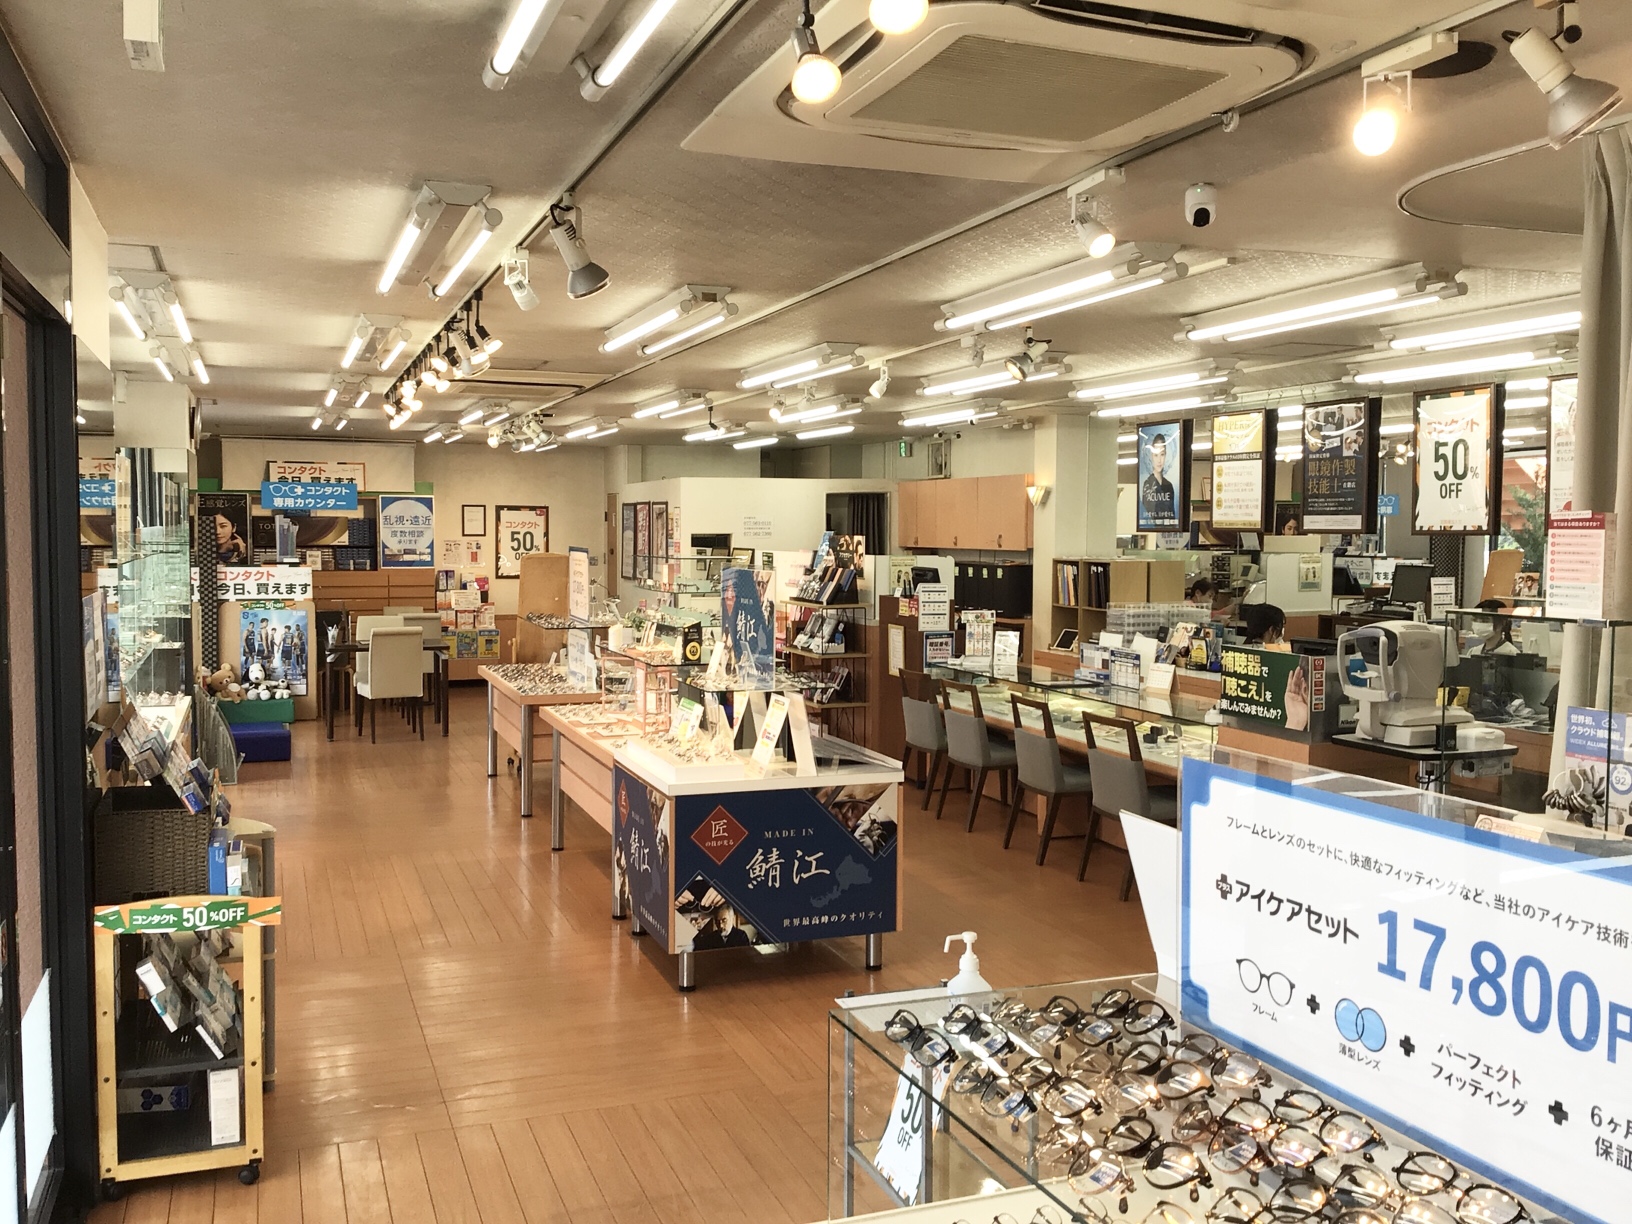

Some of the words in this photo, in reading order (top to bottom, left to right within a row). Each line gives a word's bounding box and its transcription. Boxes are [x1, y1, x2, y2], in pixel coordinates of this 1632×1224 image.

[1308, 459, 1356, 476] 眼鏡作製
[1434, 439, 1479, 481] 50%
[277, 466, 326, 475] コンタクト
[278, 476, 356, 484] 今日買えます
[1308, 479, 1341, 494] 技能士
[307, 487, 350, 496] コンタクト
[1147, 492, 1170, 501] ACUVUE
[1440, 483, 1462, 499] OFF
[273, 498, 346, 508] 専用カウンター
[383, 515, 432, 526] 乱視・遠近
[505, 521, 540, 529] コンタクト
[390, 530, 424, 538] 度数相談
[217, 571, 276, 581] コンタクト
[218, 583, 311, 595] 今日、買えます
[1221, 650, 1269, 677] 補聴器で
[1221, 675, 1272, 702] 「聴こえ」を
[1221, 699, 1282, 720] 楽しんでみませんか?
[1570, 713, 1596, 726] 世界初、
[1615, 776, 1626, 786] 92
[711, 819, 728, 838] 匠
[764, 829, 796, 839] MADE
[803, 828, 814, 836] IN
[705, 839, 734, 847] の技が光る
[746, 847, 831, 889] 鯖江
[1227, 816, 1632, 949] フレームとレンズのセットに、快適なフィッティングなど、当社のアイケア技術
[132, 913, 178, 925] コンタクト
[783, 911, 884, 928] 世界最高峰のクオリティ
[1235, 880, 1360, 944] アイケアセット
[1251, 1002, 1278, 1022] フレーム
[1338, 1042, 1381, 1072] 薄型レンズ
[1437, 1042, 1522, 1089] パーフェクト
[1431, 1061, 1528, 1117] フィッティング
[897, 1126, 913, 1152] OFF
[1595, 1136, 1632, 1171] 保証
